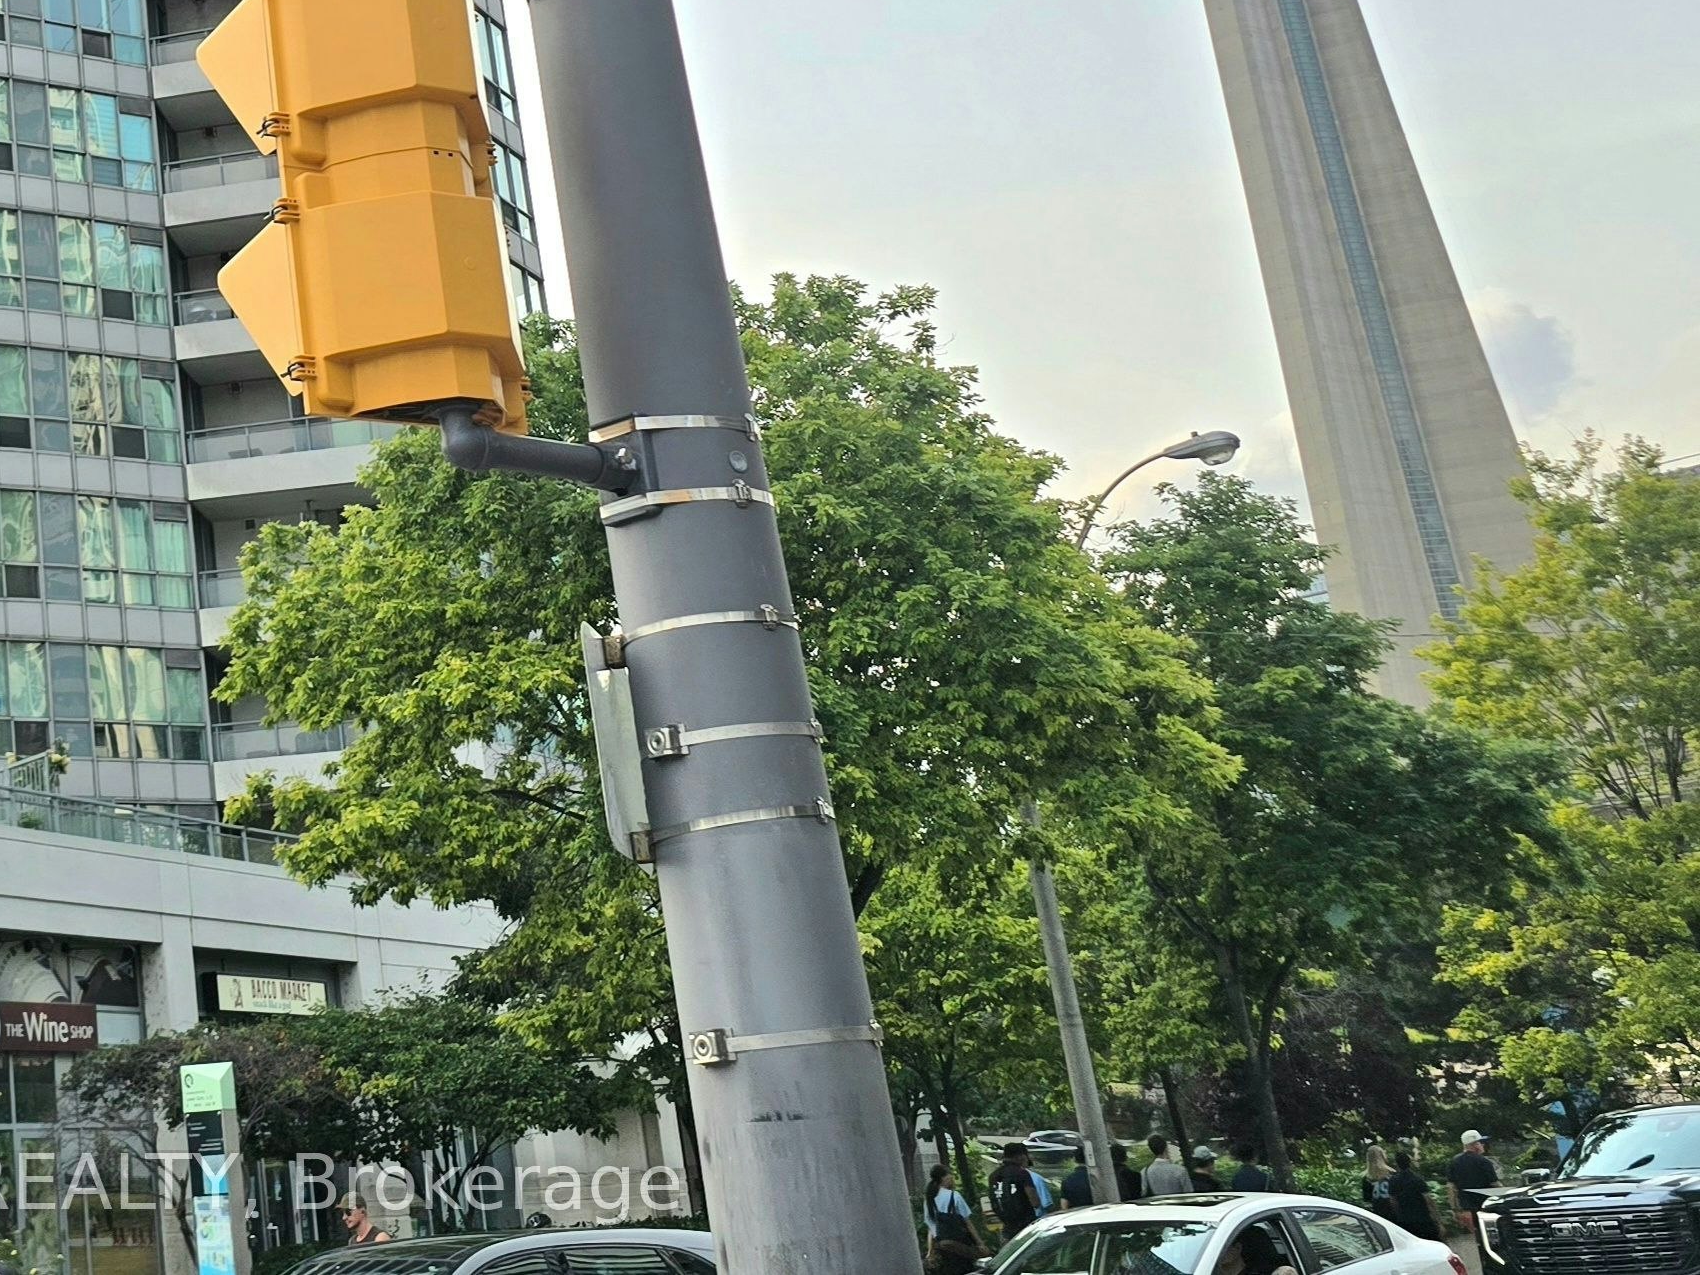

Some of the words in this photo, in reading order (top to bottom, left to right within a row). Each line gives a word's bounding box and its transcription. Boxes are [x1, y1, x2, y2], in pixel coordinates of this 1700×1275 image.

[4, 1023, 25, 1038] THE
[22, 1011, 69, 1043] Wine
[69, 1025, 94, 1039] SHOP
[1550, 1220, 1620, 1237] GMC
